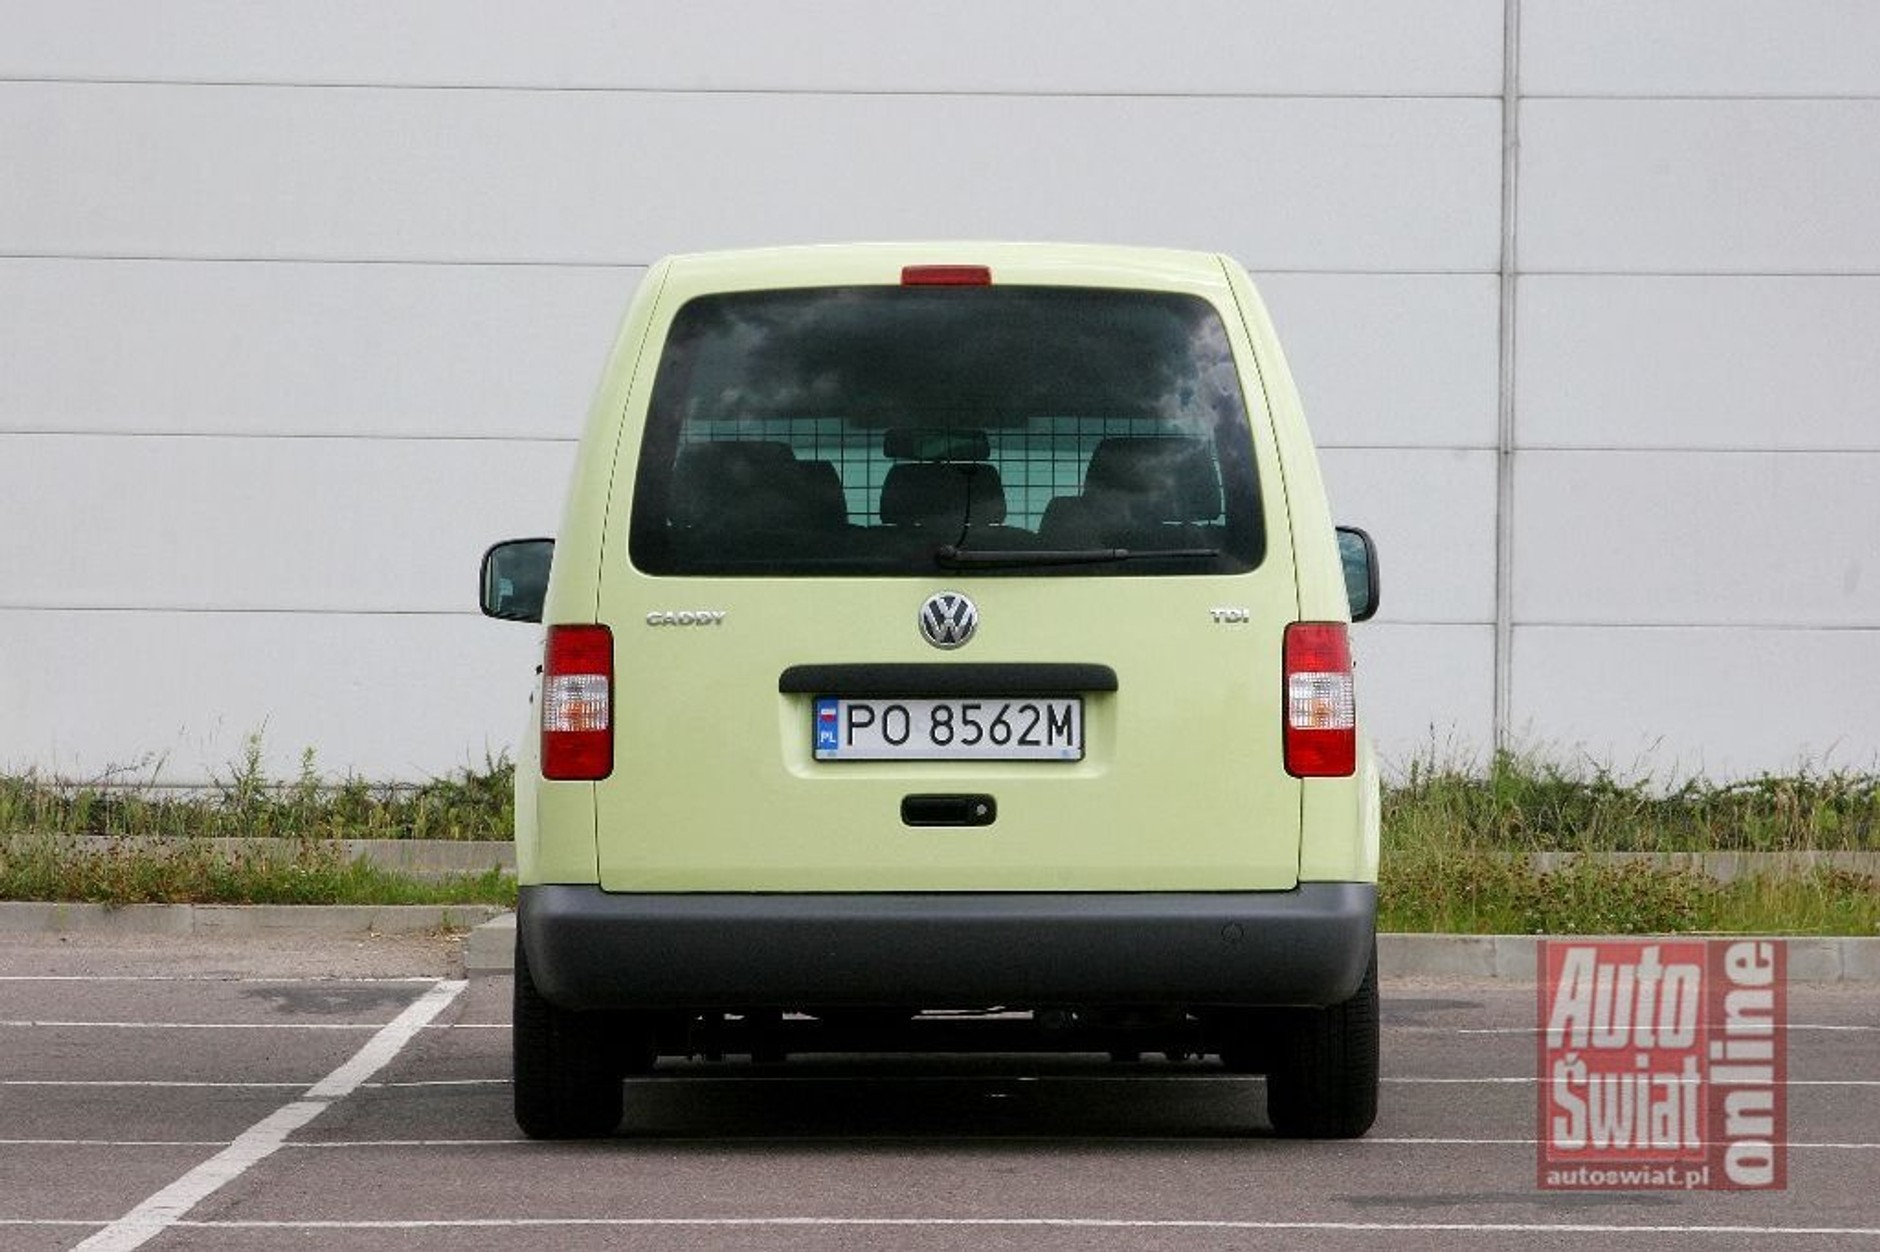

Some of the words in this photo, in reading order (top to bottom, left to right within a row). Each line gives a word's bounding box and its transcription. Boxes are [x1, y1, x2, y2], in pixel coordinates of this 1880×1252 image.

[646, 611, 726, 626] CADDY
[1210, 609, 1249, 624] TDI
[847, 704, 910, 746] PO
[930, 703, 1073, 746] 8562M
[820, 732, 837, 744] PL
